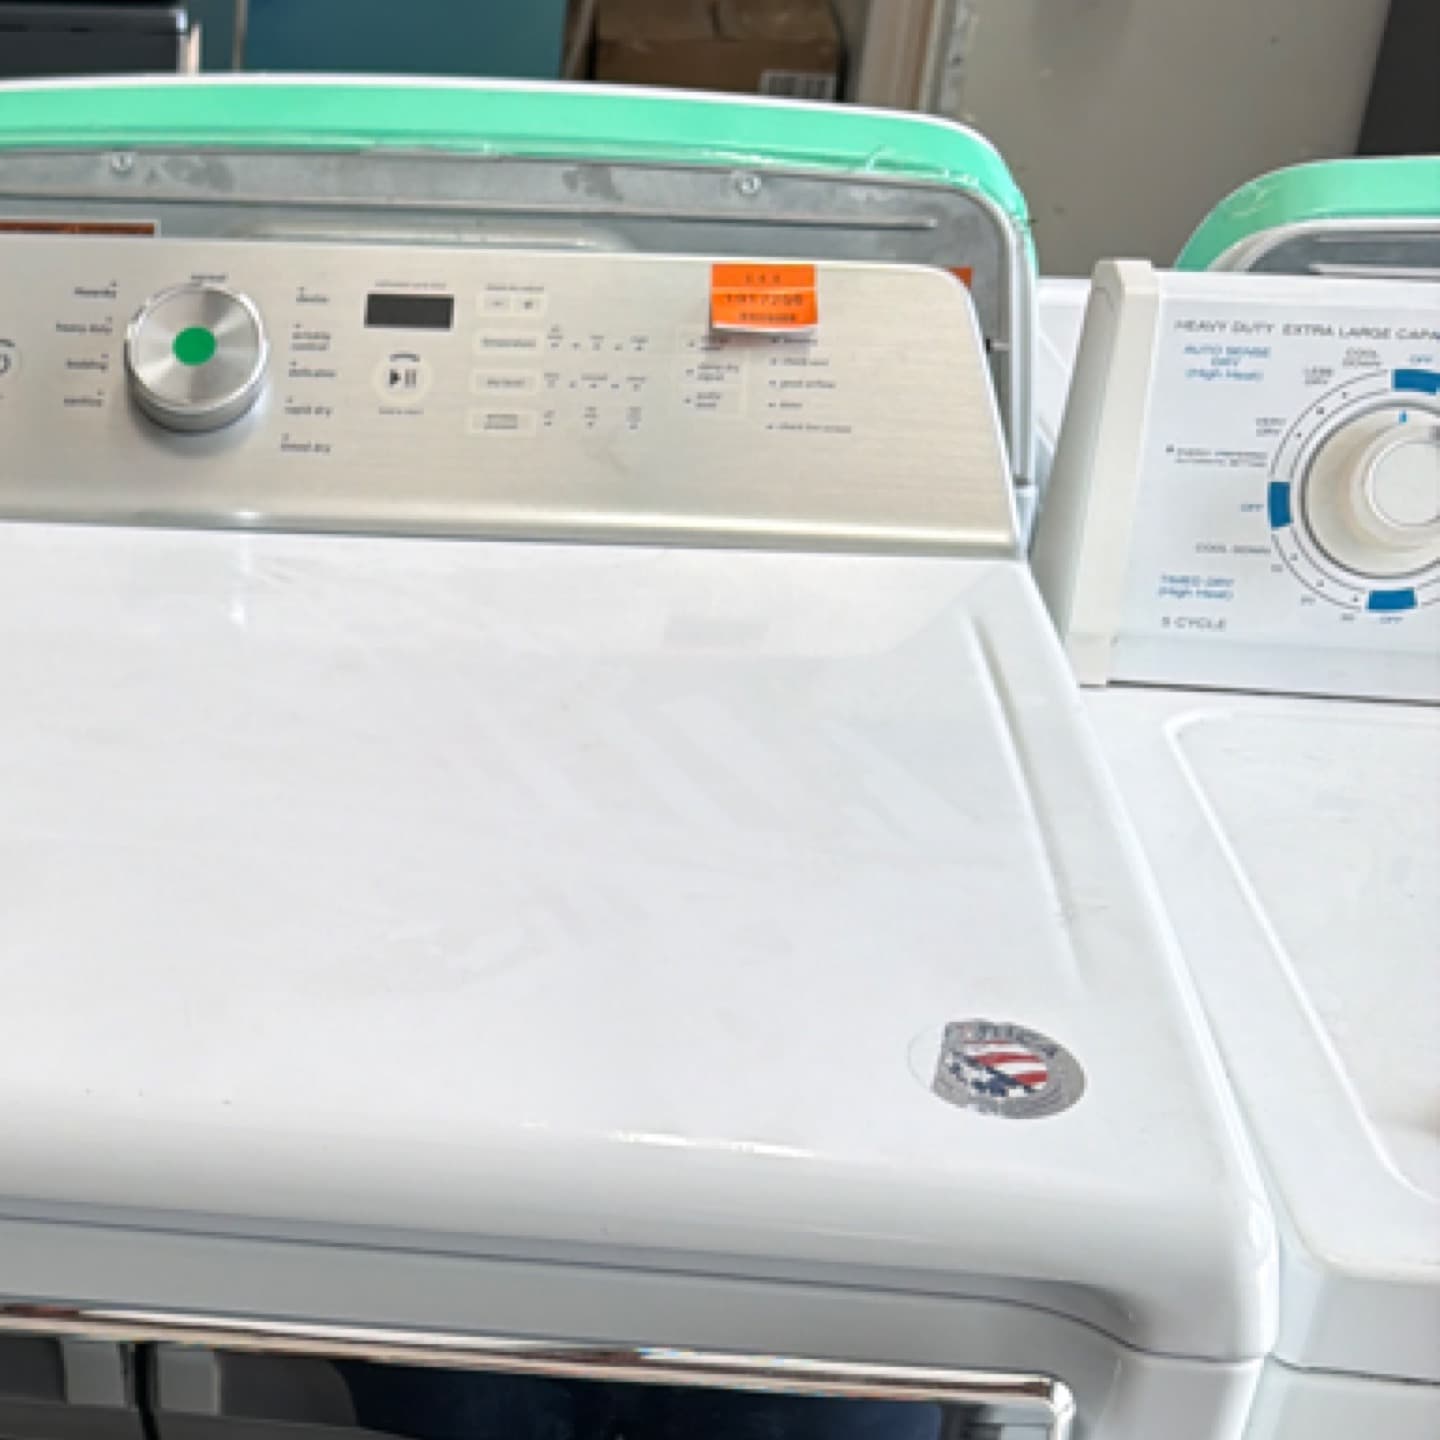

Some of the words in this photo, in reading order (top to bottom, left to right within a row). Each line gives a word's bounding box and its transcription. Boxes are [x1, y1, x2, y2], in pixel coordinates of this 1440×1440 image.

[1175, 320, 1227, 333] HEAVY
[1231, 322, 1275, 334] DUTY
[1283, 324, 1335, 337] EXTRA
[1339, 327, 1391, 340] LARGE
